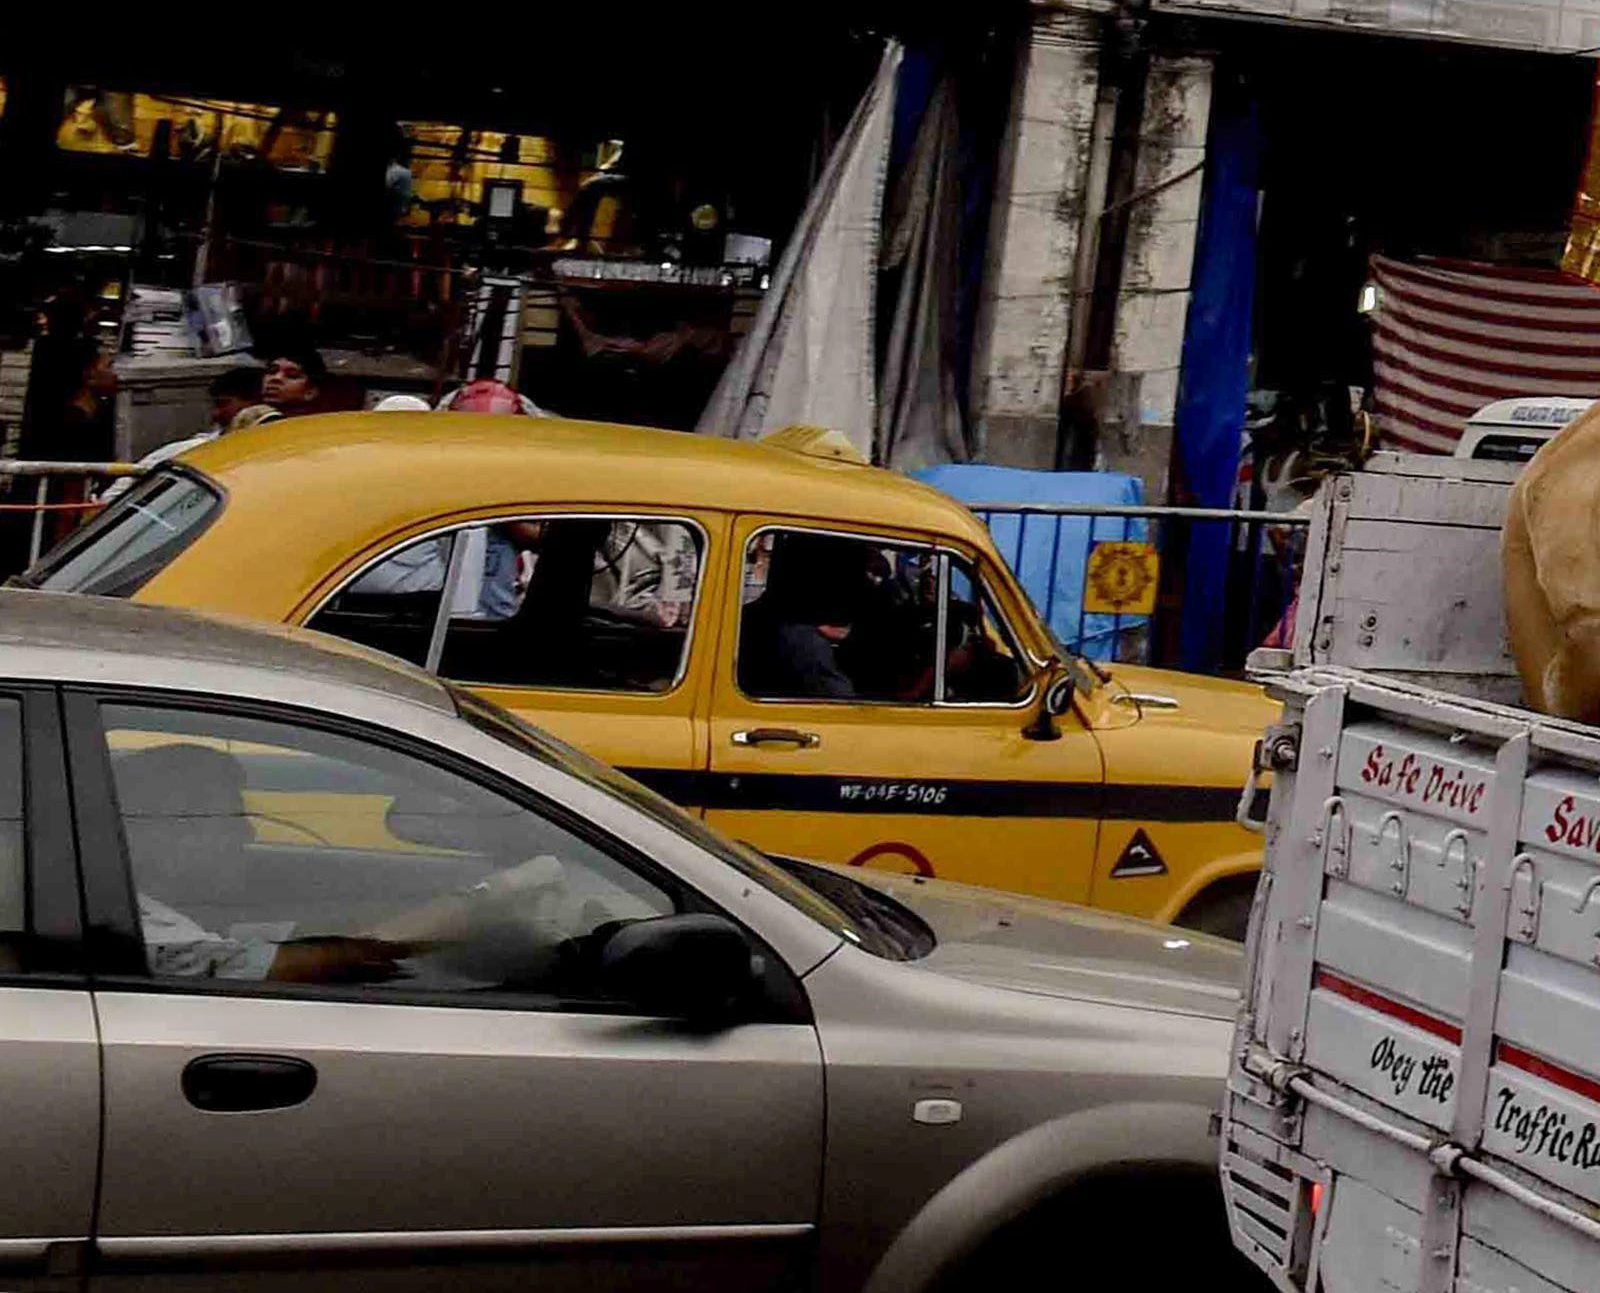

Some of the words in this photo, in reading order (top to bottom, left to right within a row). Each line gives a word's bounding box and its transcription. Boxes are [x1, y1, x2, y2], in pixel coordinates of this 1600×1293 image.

[1361, 744, 1420, 796] Safe
[1423, 764, 1486, 814] Drive
[1371, 1036, 1417, 1096] Obey
[1494, 1087, 1574, 1154] Traffic
